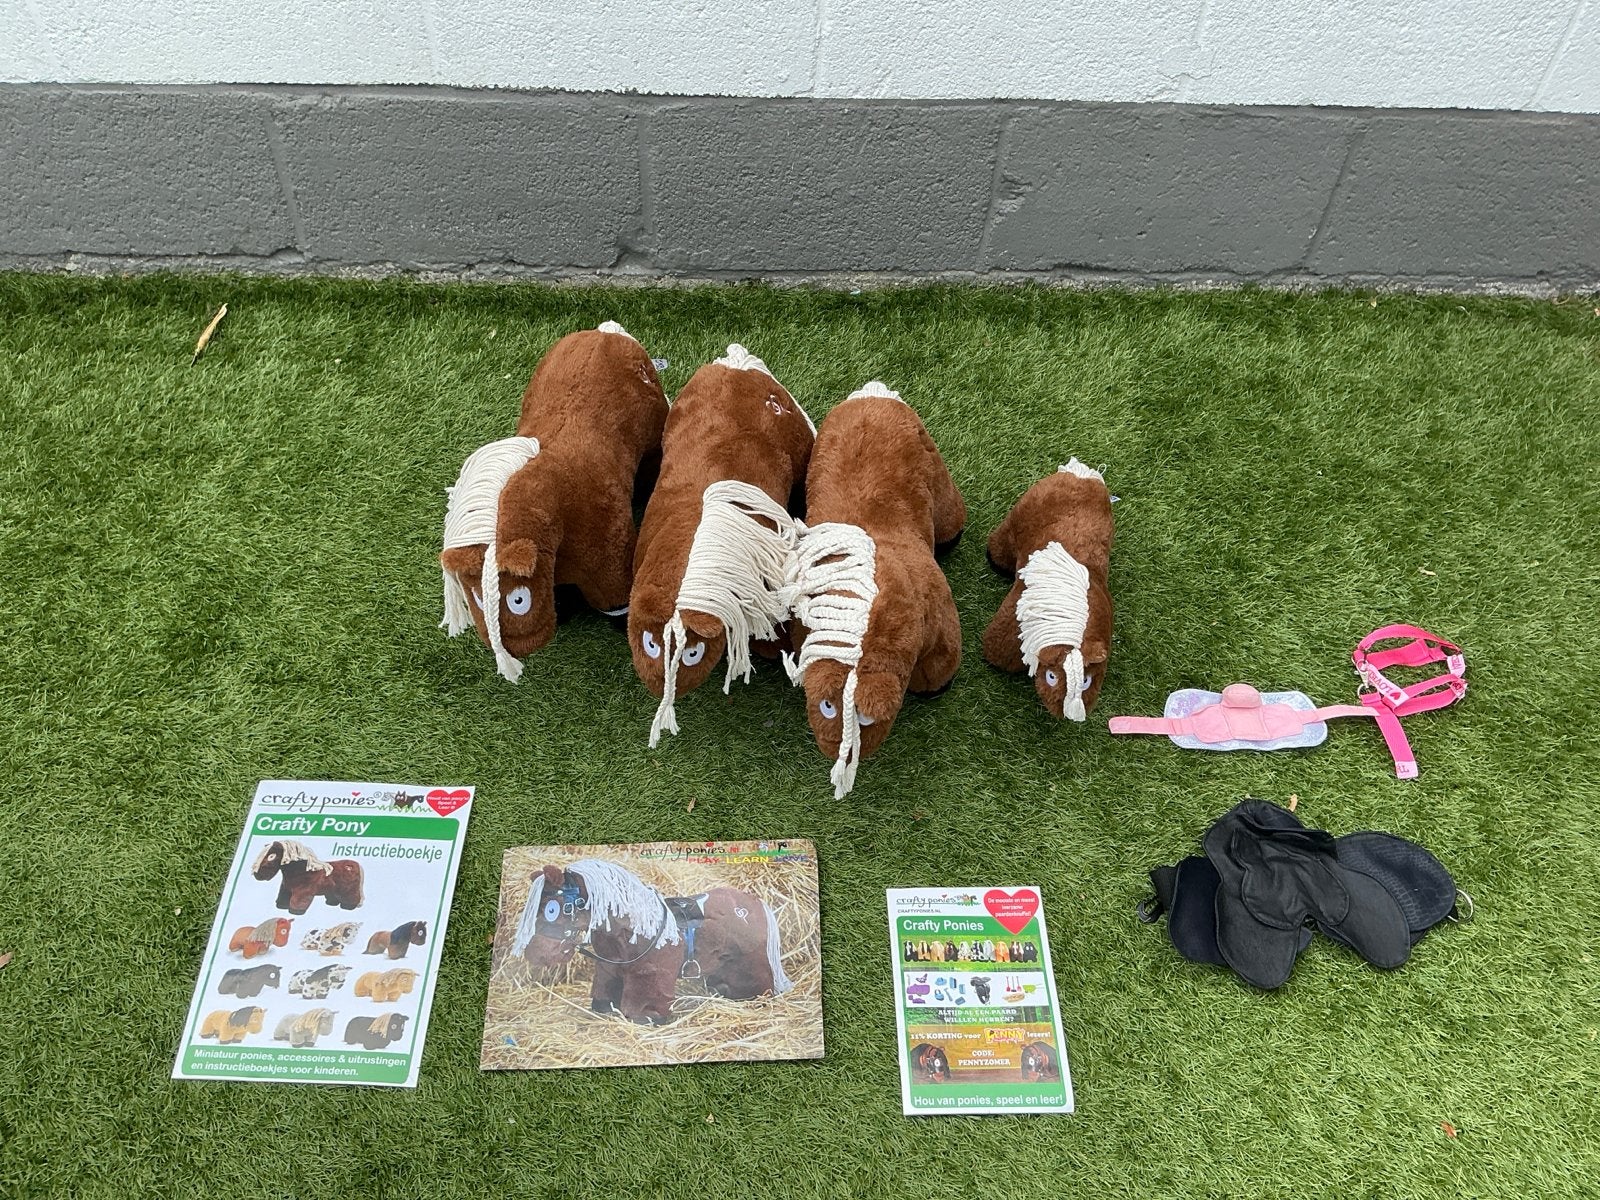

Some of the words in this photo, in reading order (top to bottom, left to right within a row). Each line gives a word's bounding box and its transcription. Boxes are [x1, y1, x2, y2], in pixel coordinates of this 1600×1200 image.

[261, 791, 318, 812] crafty
[319, 792, 376, 813] ponies
[257, 816, 317, 834] Crafty
[321, 817, 371, 835] Pony
[332, 842, 443, 862] Instructieboekje
[640, 844, 682, 861] crafty
[726, 856, 769, 864] LEARN
[896, 896, 926, 908] crafty
[927, 894, 956, 908] ponies
[903, 920, 940, 933] Crafty
[944, 920, 984, 931] Ponies
[986, 1029, 1023, 1042] PENNY
[194, 1049, 239, 1059] Miniatuur
[240, 1052, 275, 1062] ponies,
[277, 1053, 336, 1063] accessoires
[338, 1055, 346, 1063] &
[348, 1055, 406, 1067] uitrustingen
[191, 1062, 203, 1070] en
[205, 1061, 288, 1074] instructieboekjes
[314, 1066, 359, 1076] kinderen.
[914, 1096, 935, 1106] Hou
[958, 1096, 994, 1107] ponies,
[997, 1095, 1023, 1107] speel
[1040, 1094, 1064, 1104] leer!
